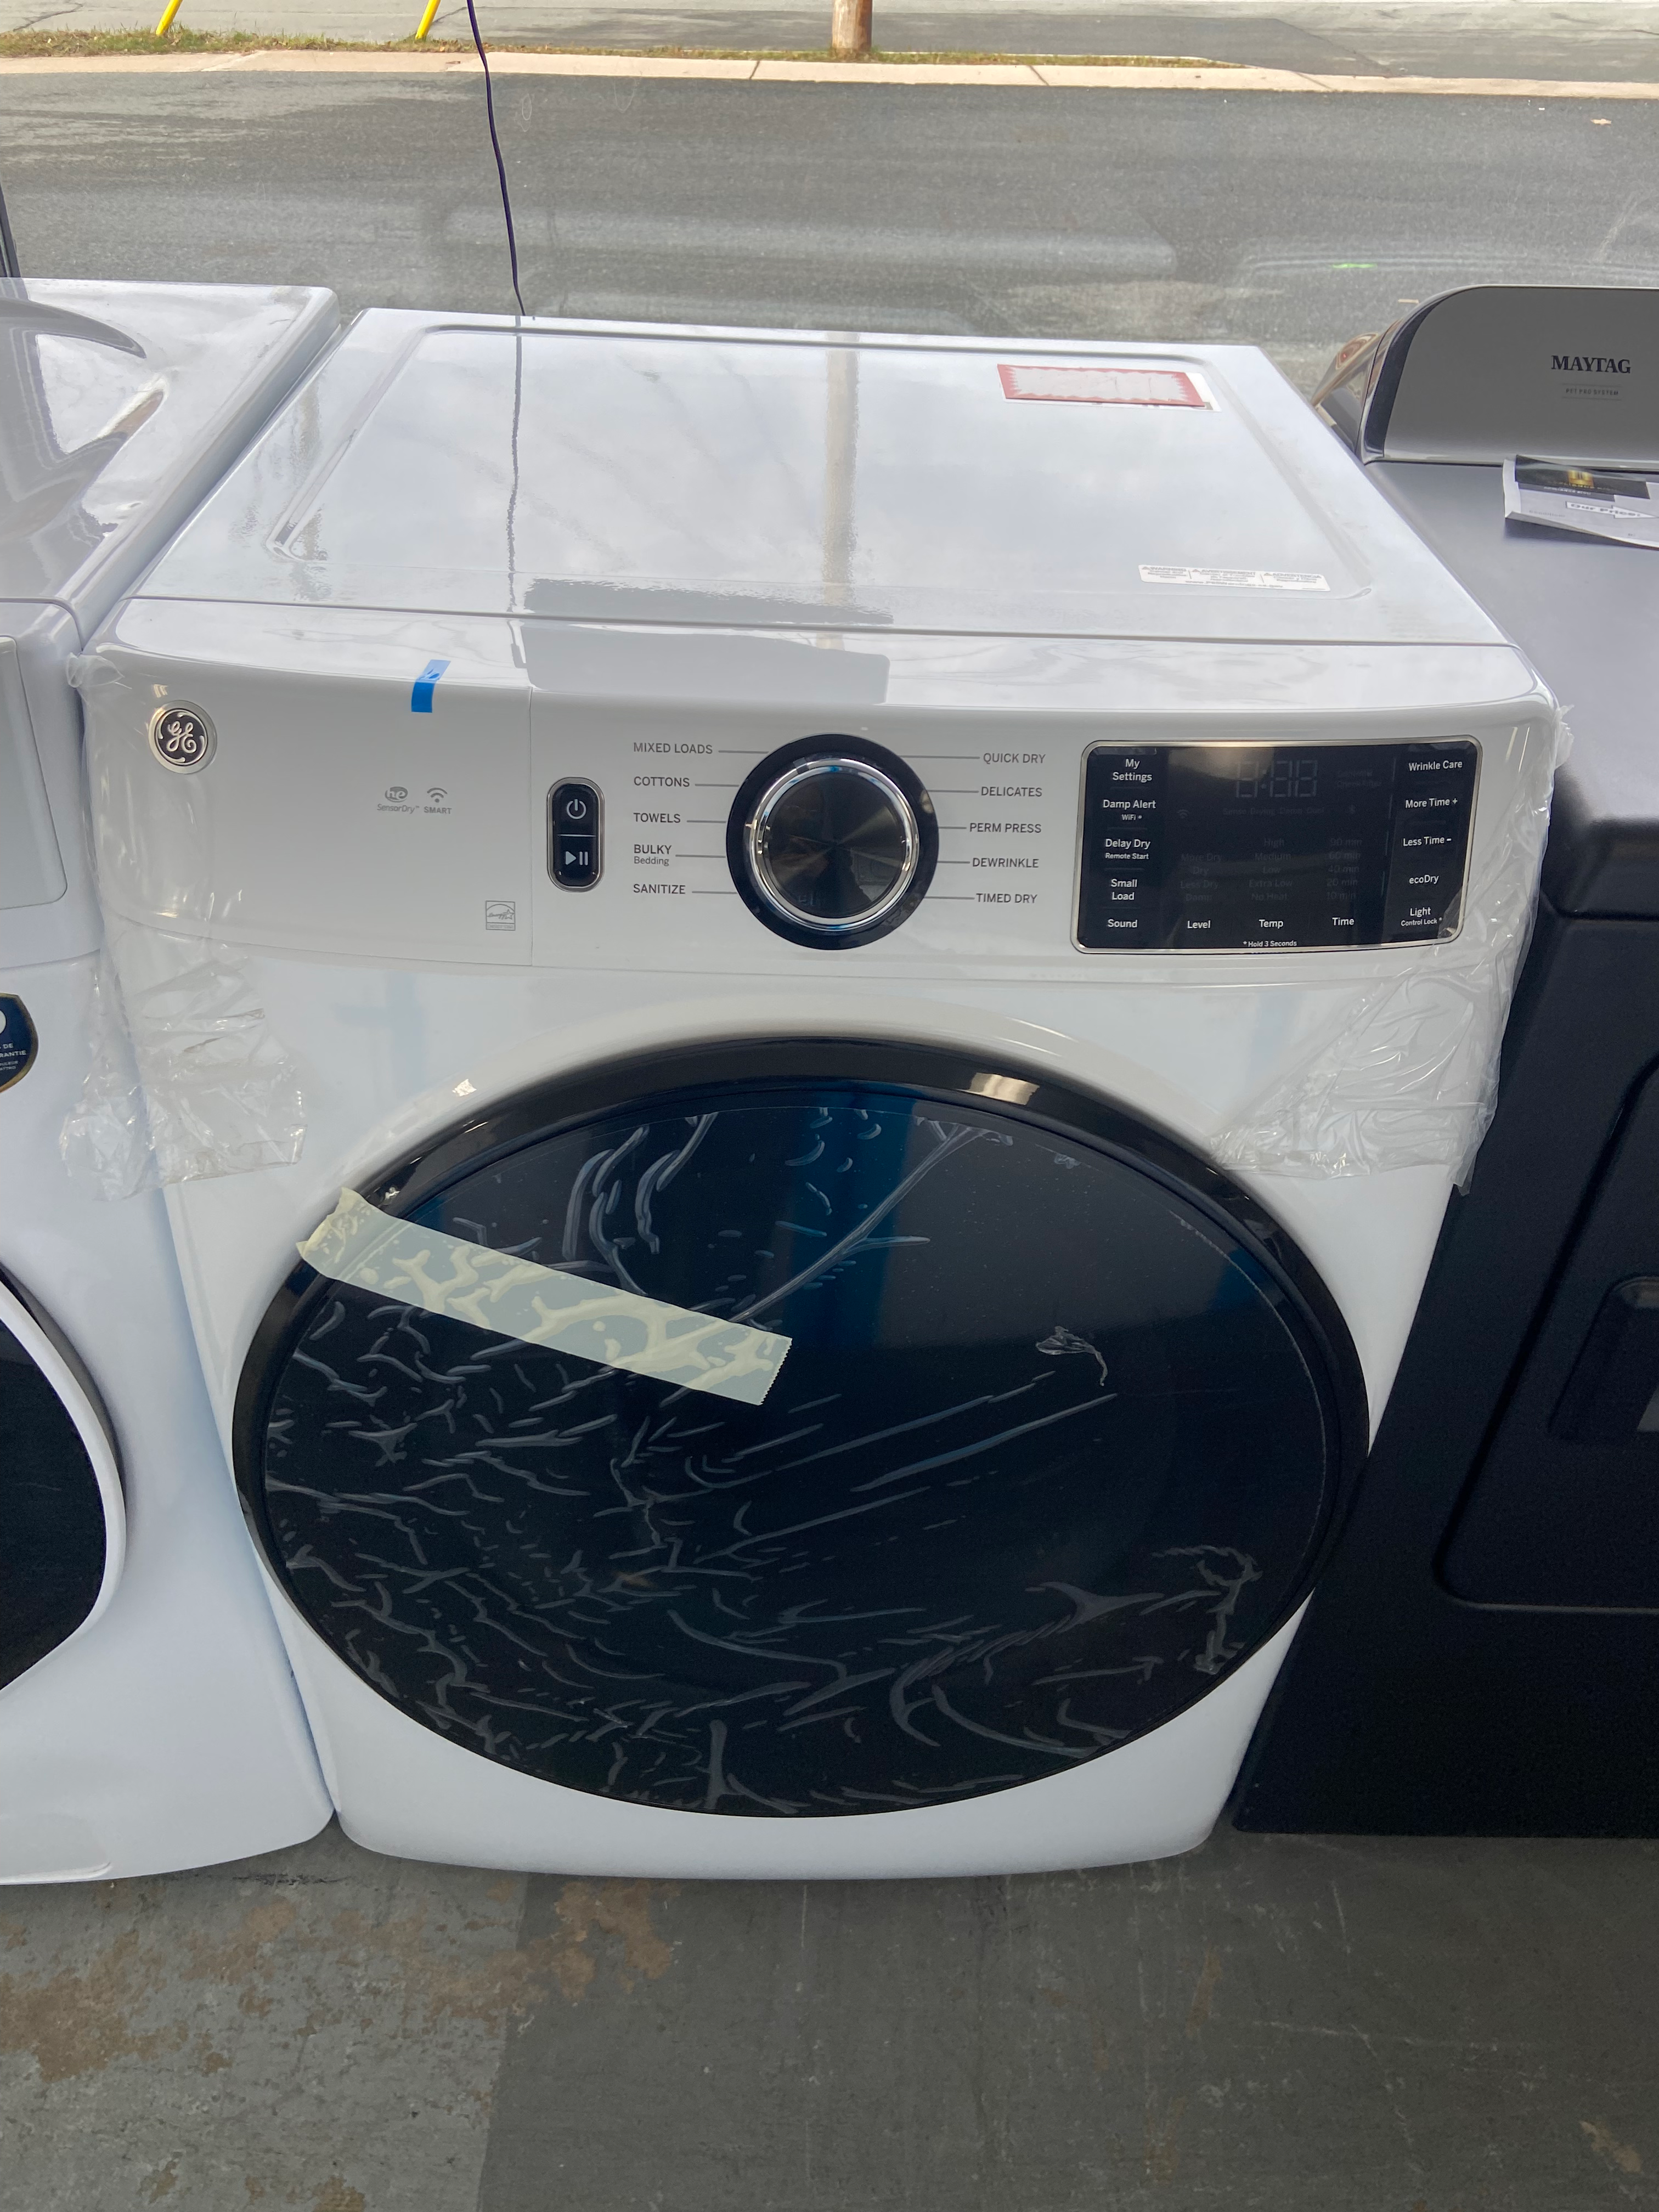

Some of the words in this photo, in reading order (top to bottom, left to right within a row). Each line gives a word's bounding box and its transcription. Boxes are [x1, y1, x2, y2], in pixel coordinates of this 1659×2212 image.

[1551, 355, 1632, 374] MAYTAG
[634, 742, 671, 753] MIXED
[674, 743, 713, 754] LOADS
[983, 753, 1019, 764] QUICK
[1023, 754, 1046, 763] DRY
[1125, 758, 1140, 769] My
[1408, 761, 1441, 771] Wrinkle
[1442, 760, 1463, 769] Care
[634, 776, 690, 787] COTTONS
[1113, 771, 1152, 783] Settings
[981, 787, 1042, 797] DELICATES
[1103, 799, 1131, 810] Damp
[1132, 799, 1156, 809] Alert
[1405, 799, 1427, 808] More
[1429, 798, 1450, 806] Time
[424, 806, 452, 814] SMART
[633, 812, 681, 823] TOWELS
[969, 822, 1002, 832] PERM
[1005, 823, 1042, 833] PRESS
[1105, 838, 1132, 849] Delay
[1133, 839, 1150, 850] Dry
[1424, 836, 1445, 845] Time
[634, 844, 672, 855] BULKY
[634, 856, 669, 867] Bedding
[972, 857, 1040, 868] DEWRINKLE
[1111, 879, 1138, 888] Small
[1409, 874, 1439, 884] ecoDry
[633, 884, 686, 894] SANITIZE
[976, 893, 1012, 903] TIMED
[1015, 894, 1037, 904] DRY
[1111, 891, 1135, 900] Load
[1410, 907, 1431, 917] Light
[1107, 919, 1138, 928] Sound
[1187, 920, 1211, 928] Level
[1259, 919, 1284, 929] Temp
[1331, 917, 1355, 926] Time
